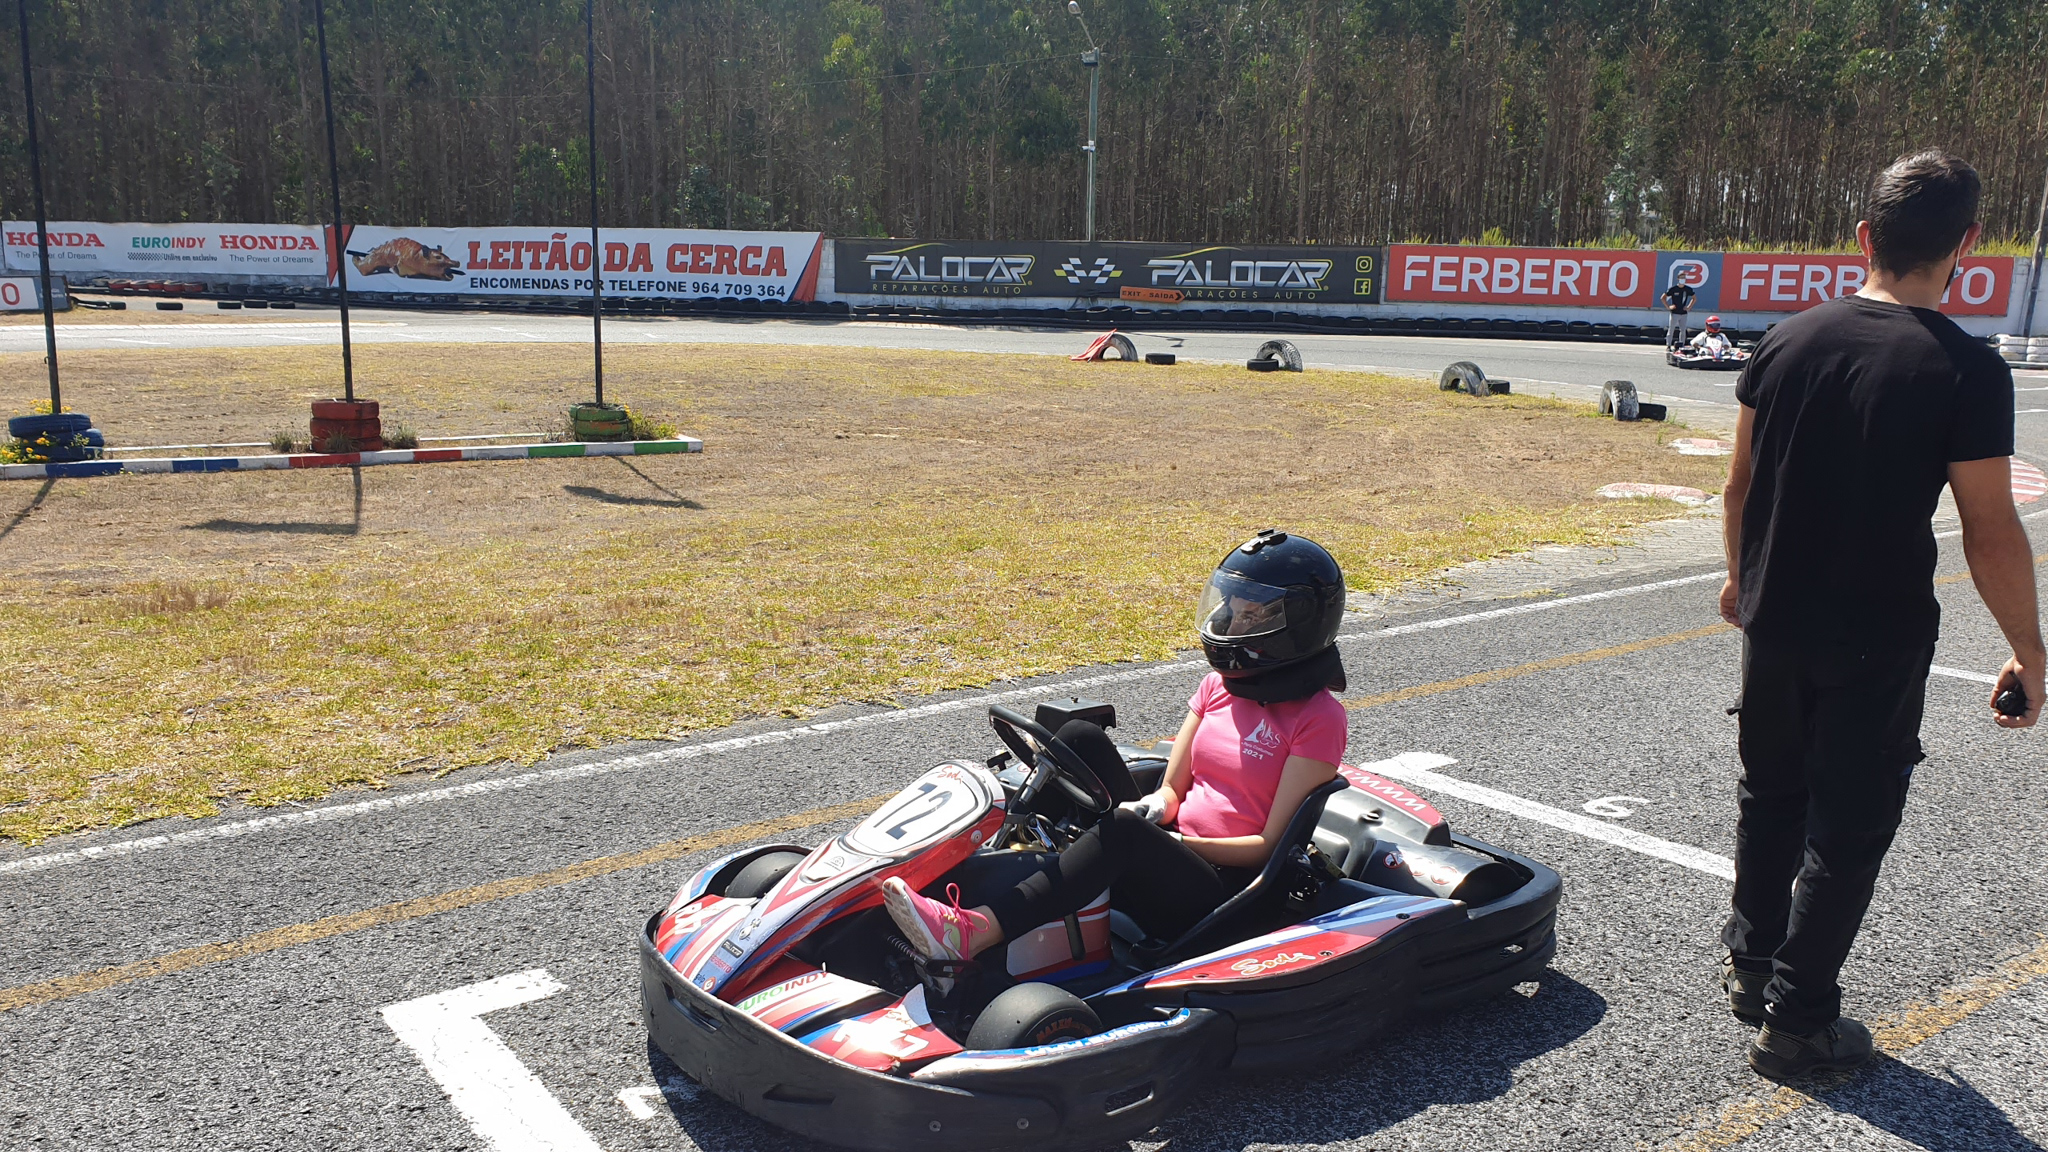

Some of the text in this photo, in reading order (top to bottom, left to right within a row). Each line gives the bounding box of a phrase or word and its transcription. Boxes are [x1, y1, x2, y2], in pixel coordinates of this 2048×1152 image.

[6, 231, 105, 247] HONDA
[132, 236, 206, 248] EUROINDY
[219, 234, 319, 250] HONDA
[16, 251, 30, 259] The
[58, 251, 65, 259] of
[67, 251, 97, 260] Dreams
[229, 254, 314, 264] The Power of Dreams
[467, 232, 788, 277] LEITÃO DA CERCA
[865, 254, 1032, 283] PALOCAR
[1147, 259, 1331, 288] PALOCAR
[1403, 255, 1639, 297] FERBERTO
[470, 277, 786, 297] ENCOMENDAS POR TELEFONE 964 709 364
[872, 283, 1022, 295] REPARAÇÕES AUTO
[1740, 263, 1996, 305] FERBO
[1274, 291, 1316, 300] AUTO
